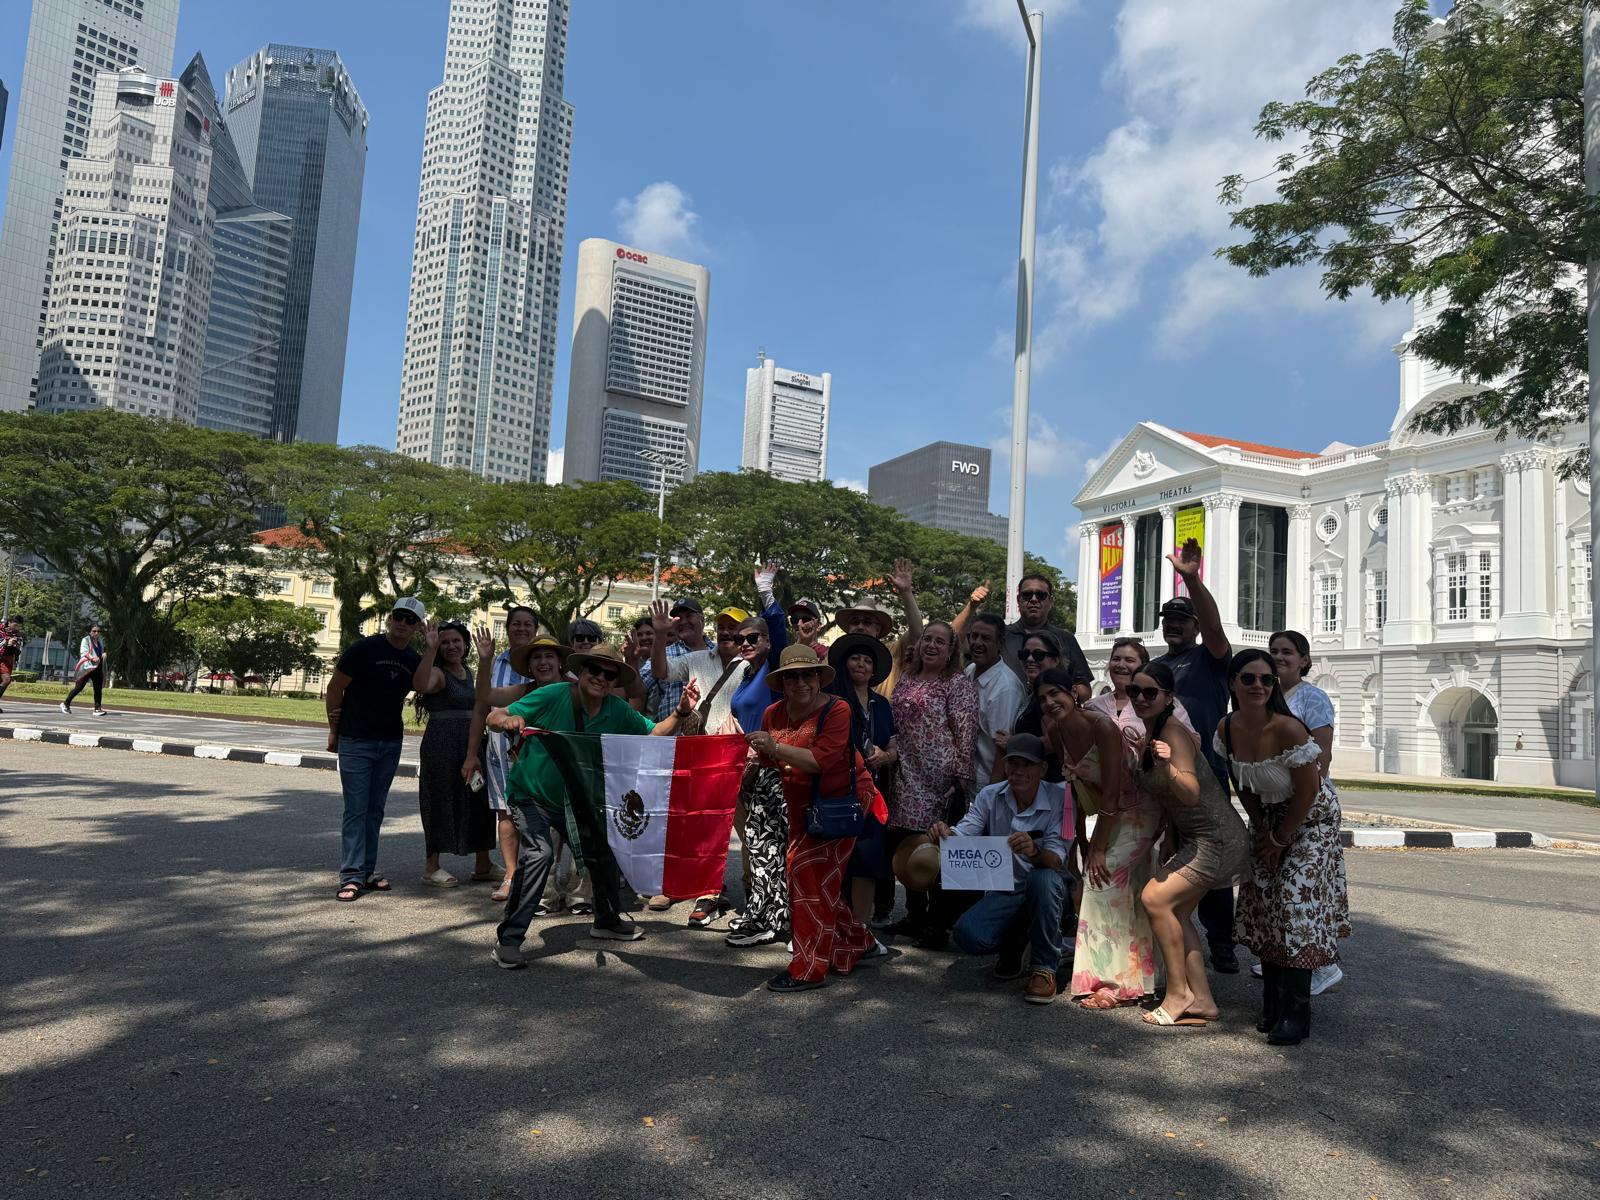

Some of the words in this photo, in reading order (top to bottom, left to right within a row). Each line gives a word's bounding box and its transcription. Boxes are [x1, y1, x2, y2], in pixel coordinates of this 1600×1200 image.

[154, 97, 175, 107] UOB
[626, 252, 648, 264] OCBC
[952, 460, 979, 475] FWD
[1103, 499, 1136, 513] VICTORIA
[1159, 485, 1192, 500] THEATRE
[948, 849, 983, 859] MEGA
[949, 860, 983, 869] TRAVEL
